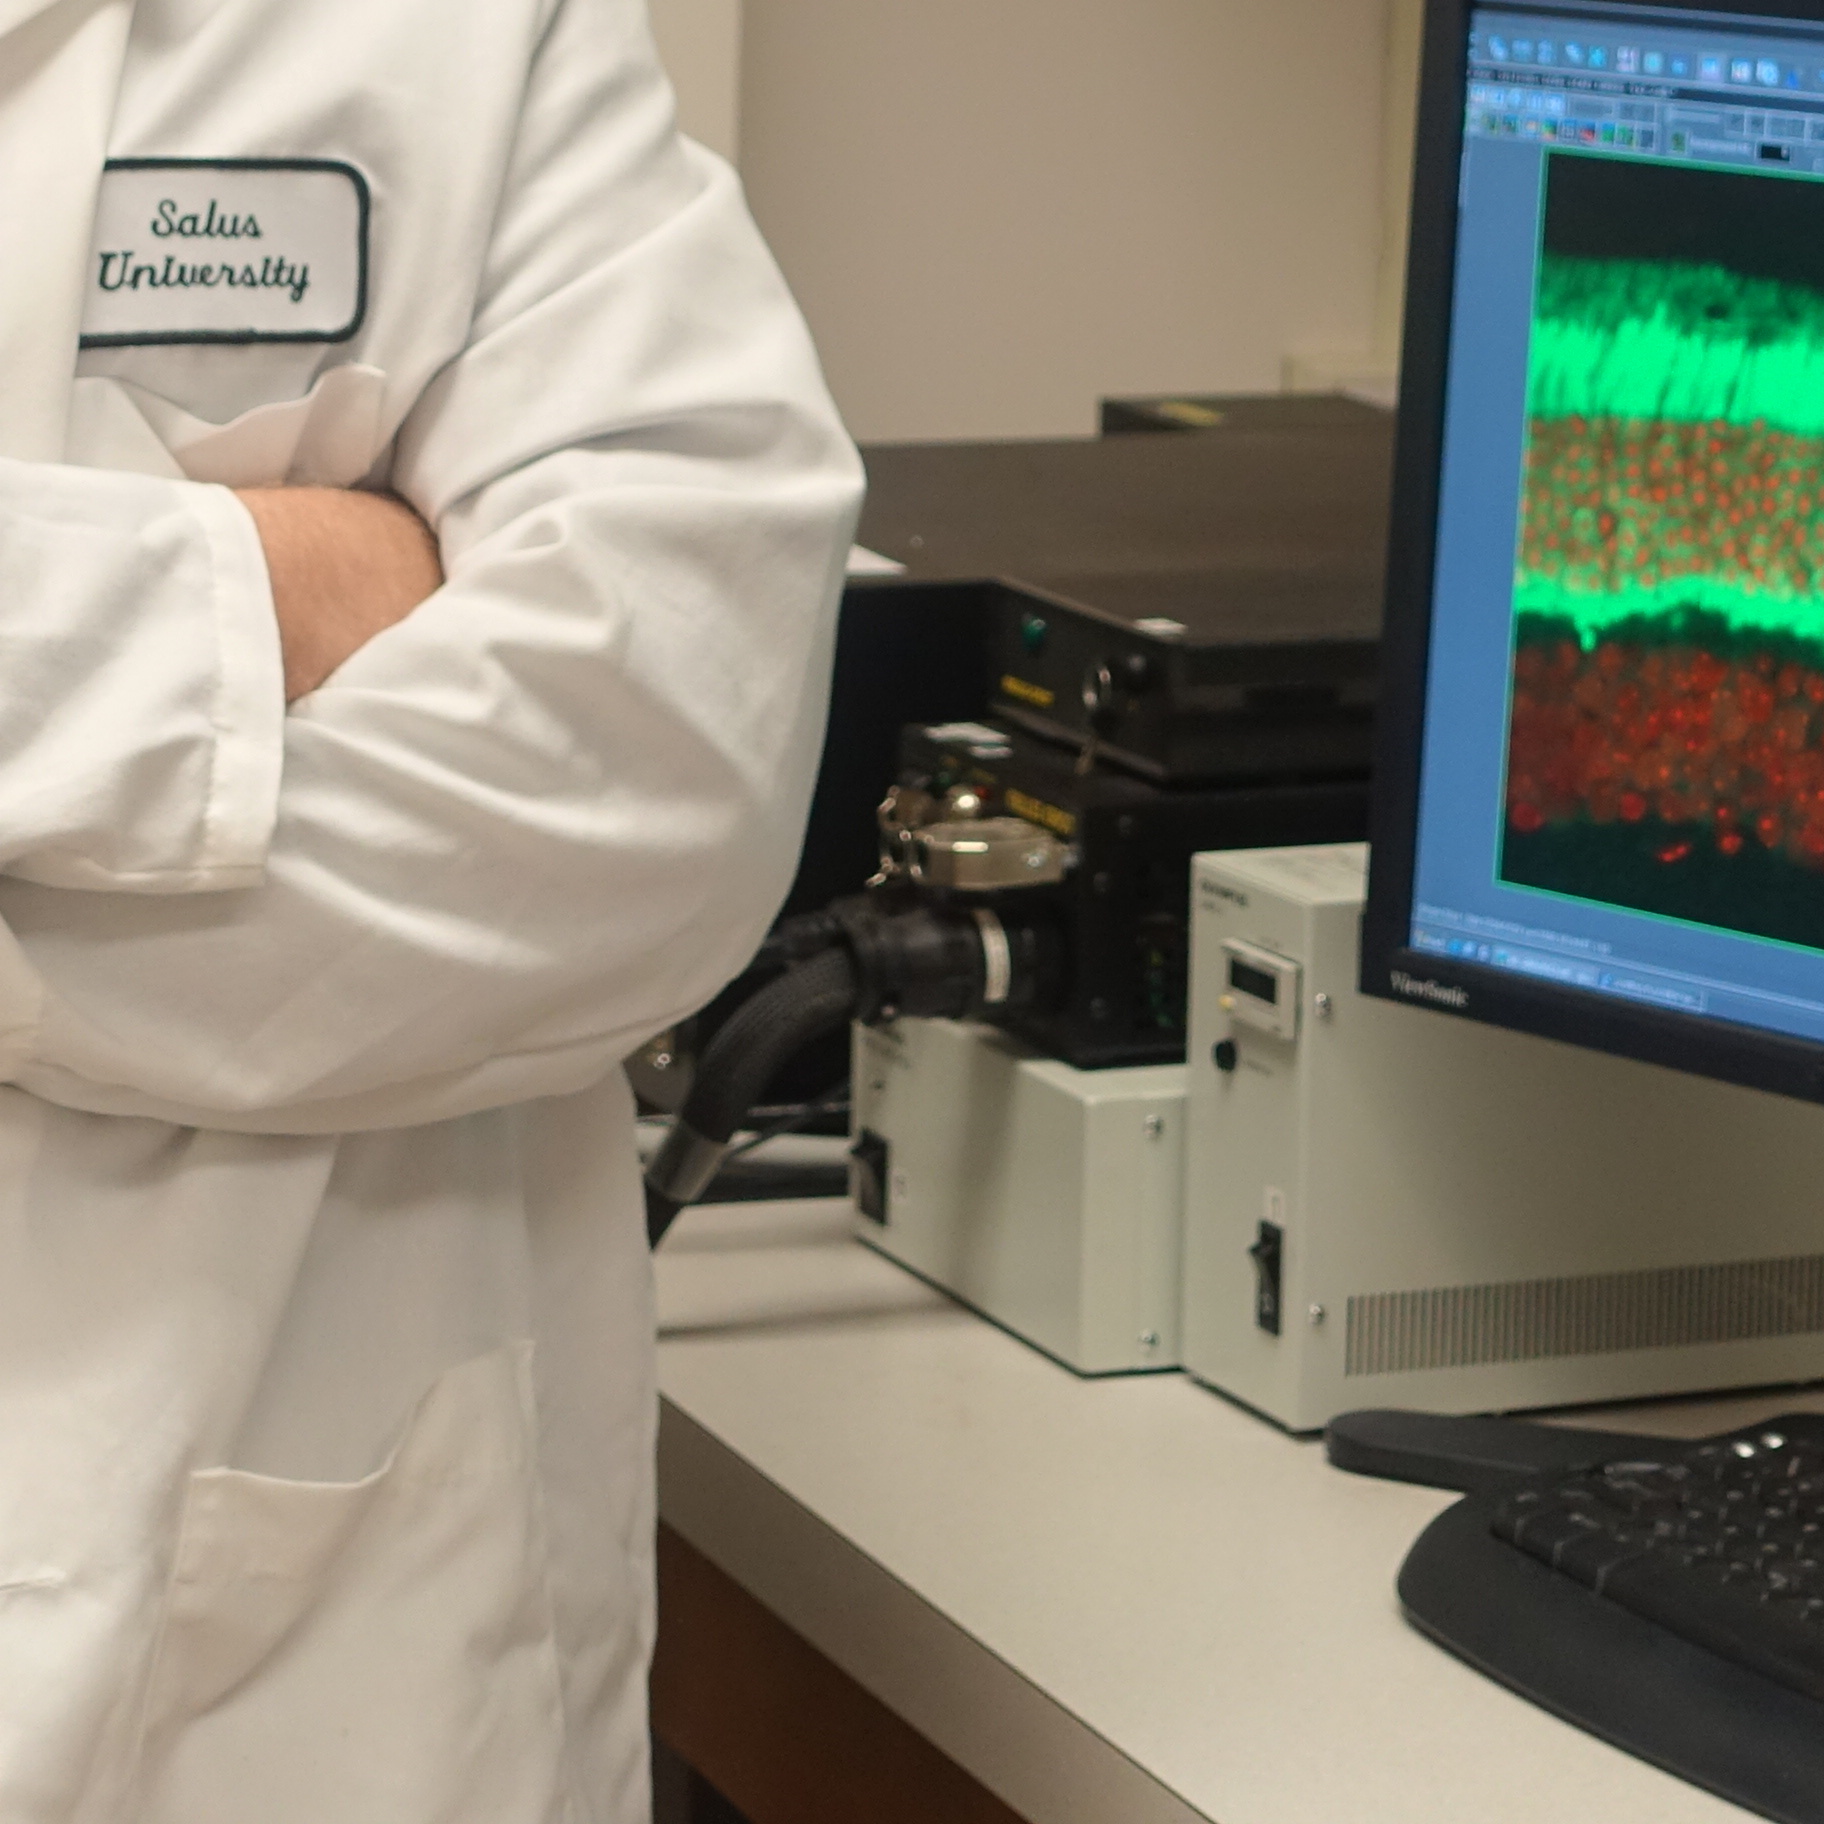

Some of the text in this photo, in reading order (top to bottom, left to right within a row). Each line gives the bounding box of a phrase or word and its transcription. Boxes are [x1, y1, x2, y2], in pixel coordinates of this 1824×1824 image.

[150, 198, 263, 238] Salus
[98, 250, 310, 303] University
[1390, 970, 1469, 1008] ViewSonic
